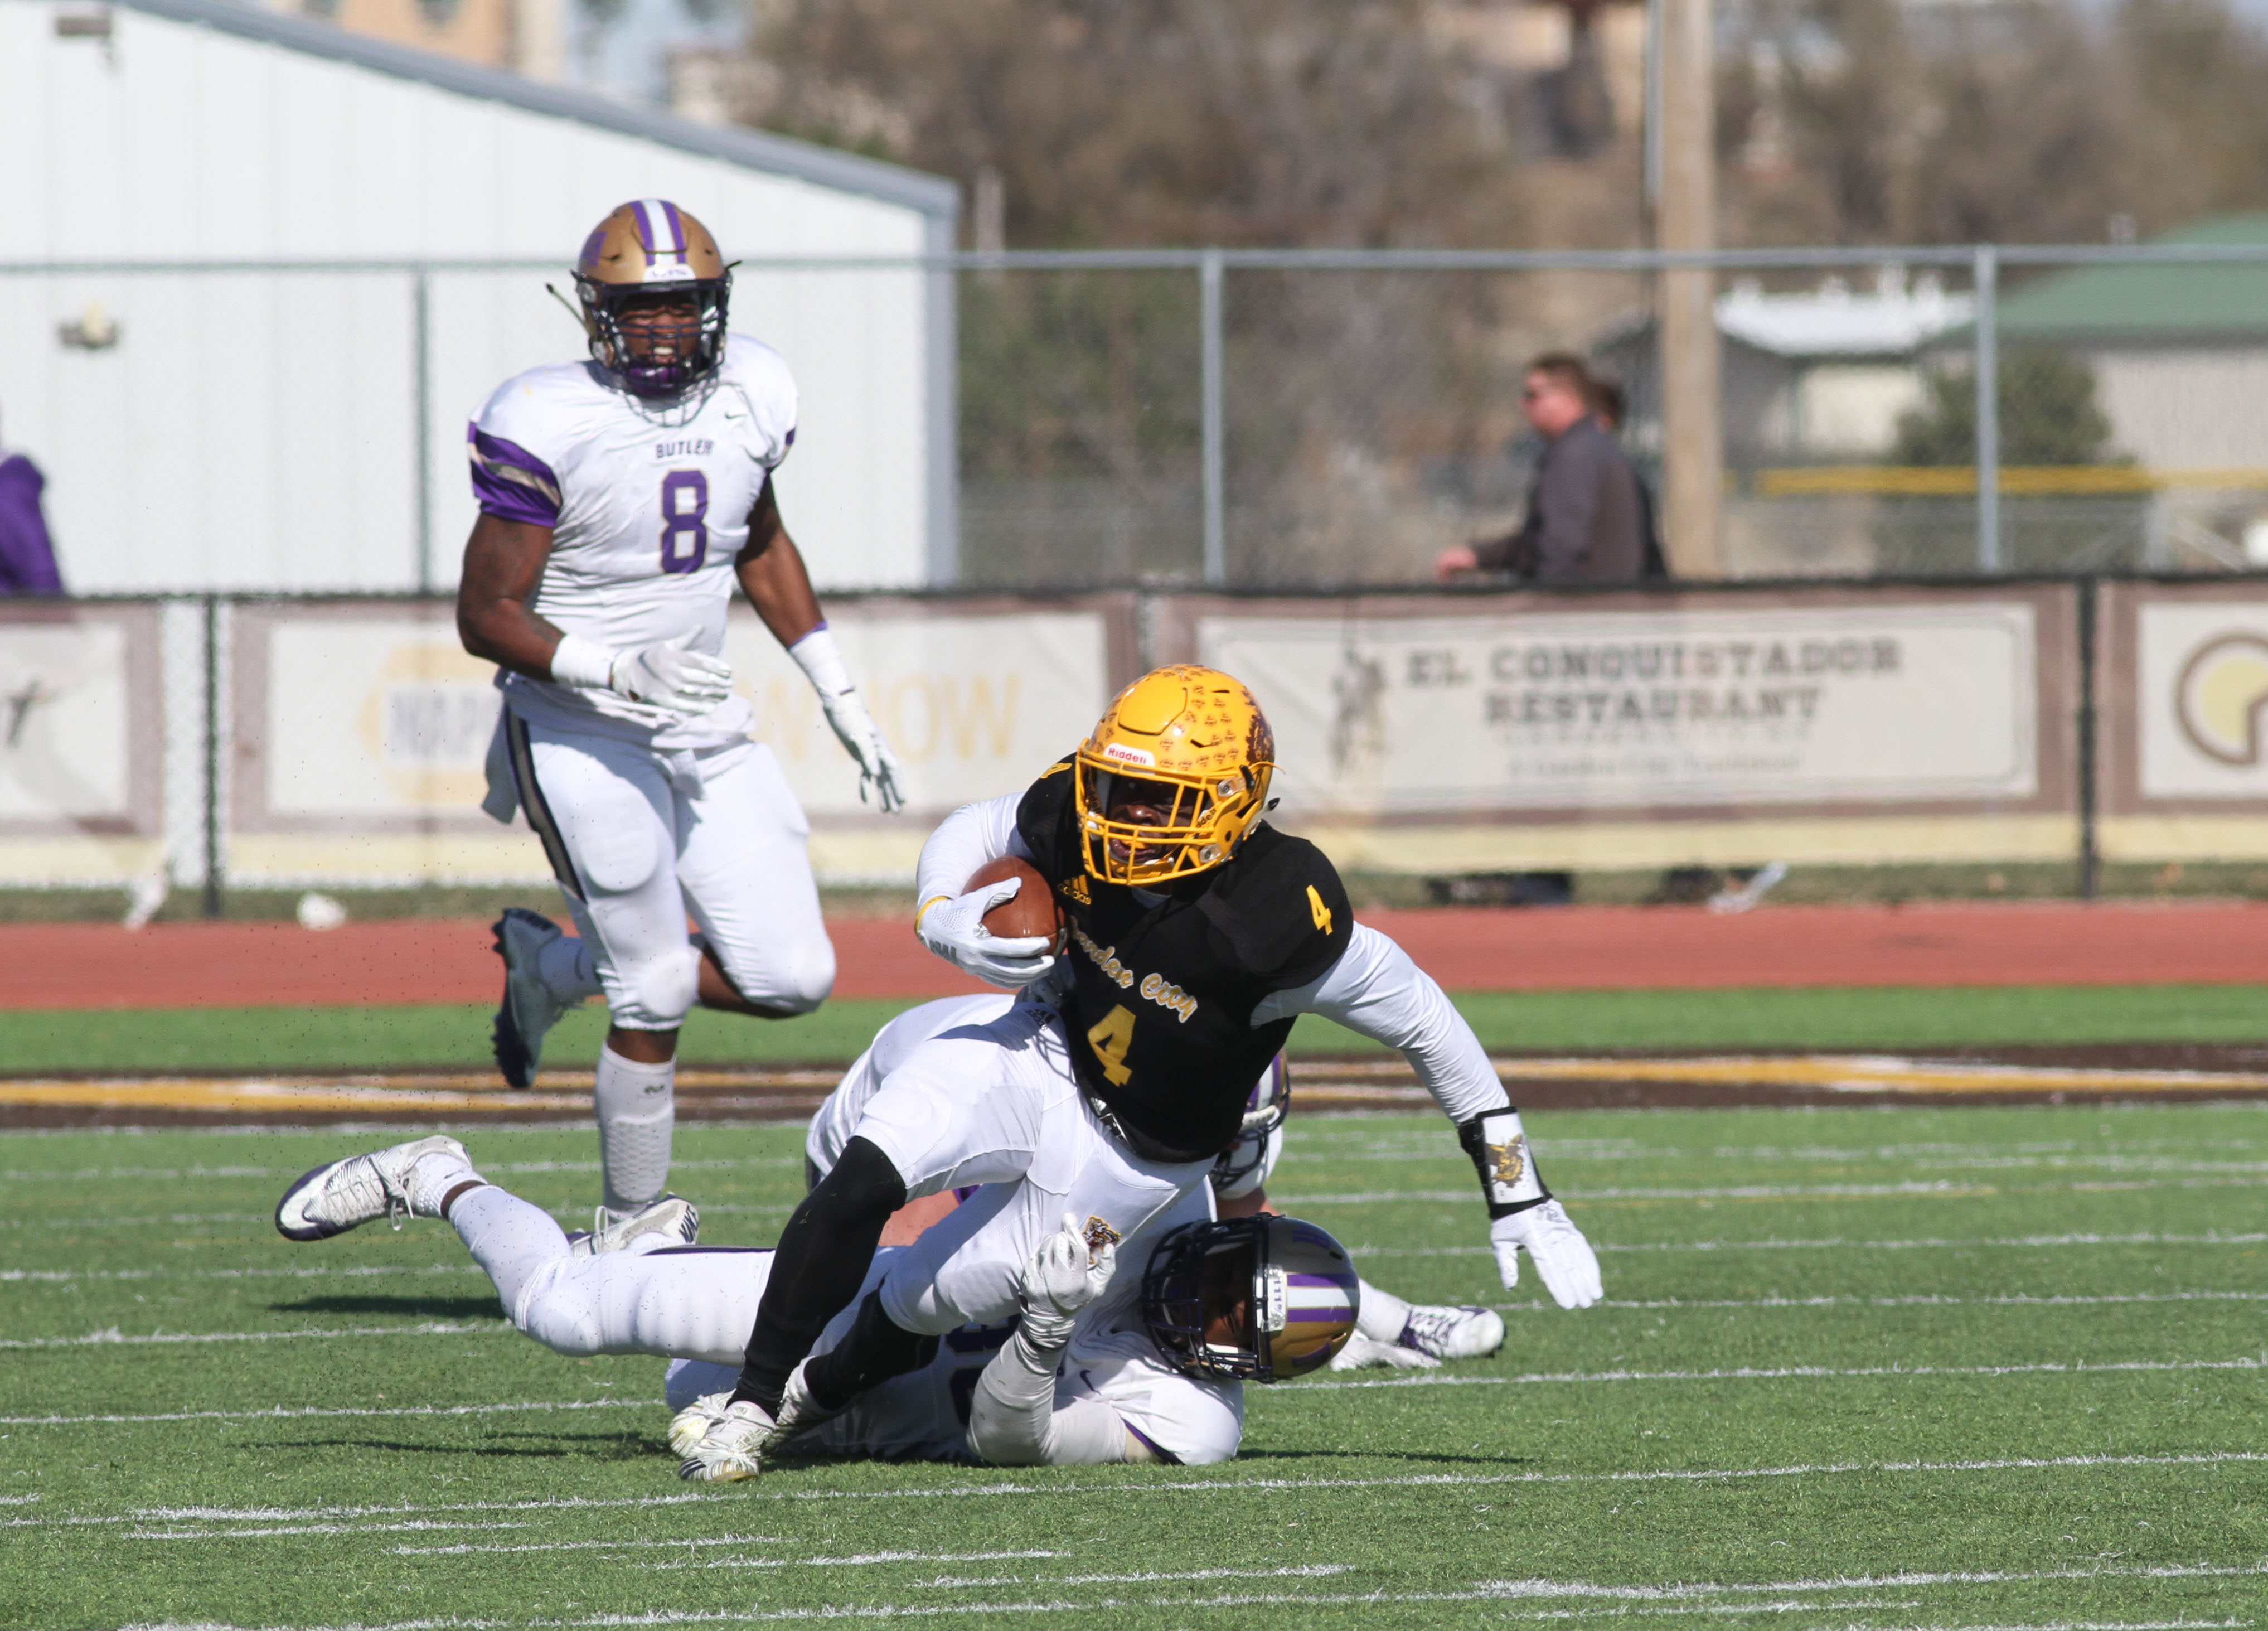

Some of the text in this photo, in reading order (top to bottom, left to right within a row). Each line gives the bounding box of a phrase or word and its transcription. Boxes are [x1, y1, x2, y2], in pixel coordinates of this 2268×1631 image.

[656, 439, 714, 459] BUTLER
[660, 468, 709, 574] 8
[1408, 639, 1898, 686] EL CONQUISTADOR
[1486, 688, 1822, 723] RESTAURANT
[1108, 748, 1147, 764] Riddell
[1306, 884, 1333, 936] 4
[1140, 972, 1196, 1023] City
[1088, 1004, 1137, 1087] 4
